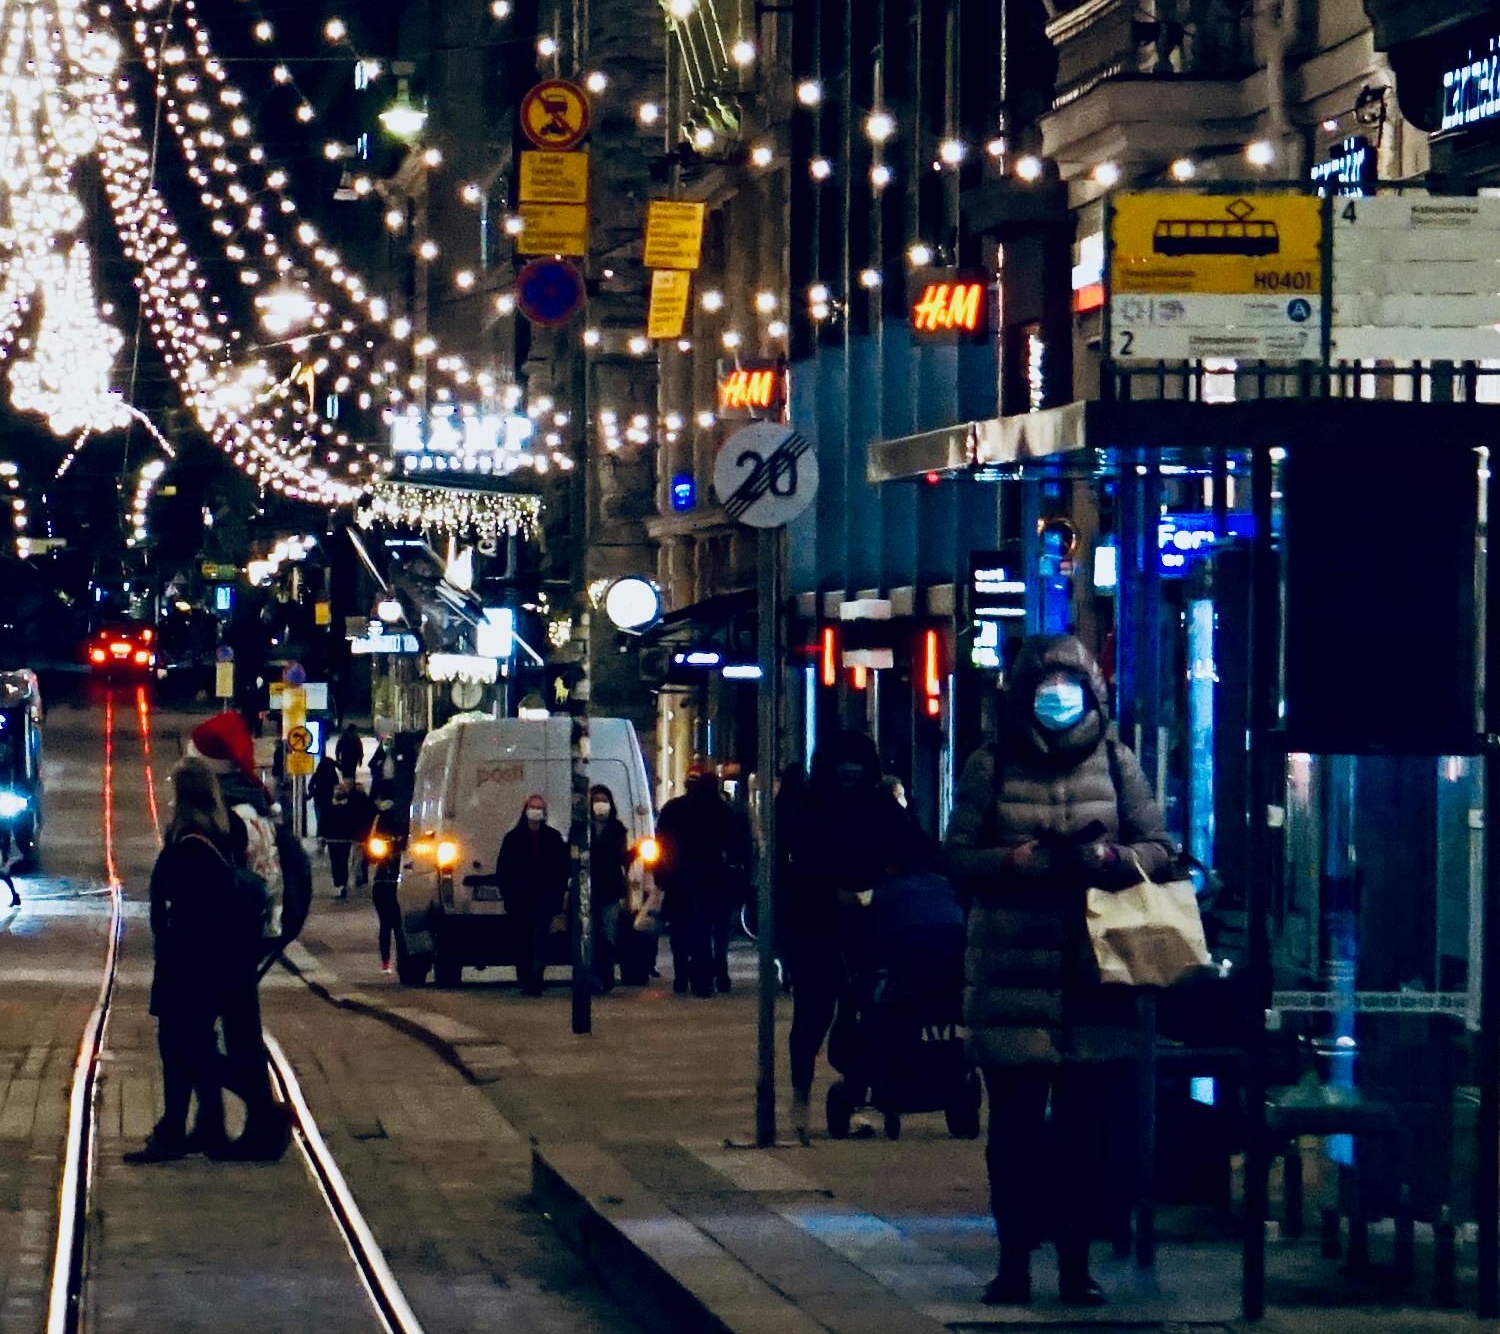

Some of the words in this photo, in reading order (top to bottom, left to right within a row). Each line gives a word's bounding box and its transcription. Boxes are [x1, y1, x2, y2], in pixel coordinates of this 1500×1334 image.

[1341, 200, 1357, 224] 4
[913, 283, 982, 331] H&M
[1120, 330, 1134, 355] 2
[722, 370, 774, 408] H&M
[736, 450, 798, 501] 20
